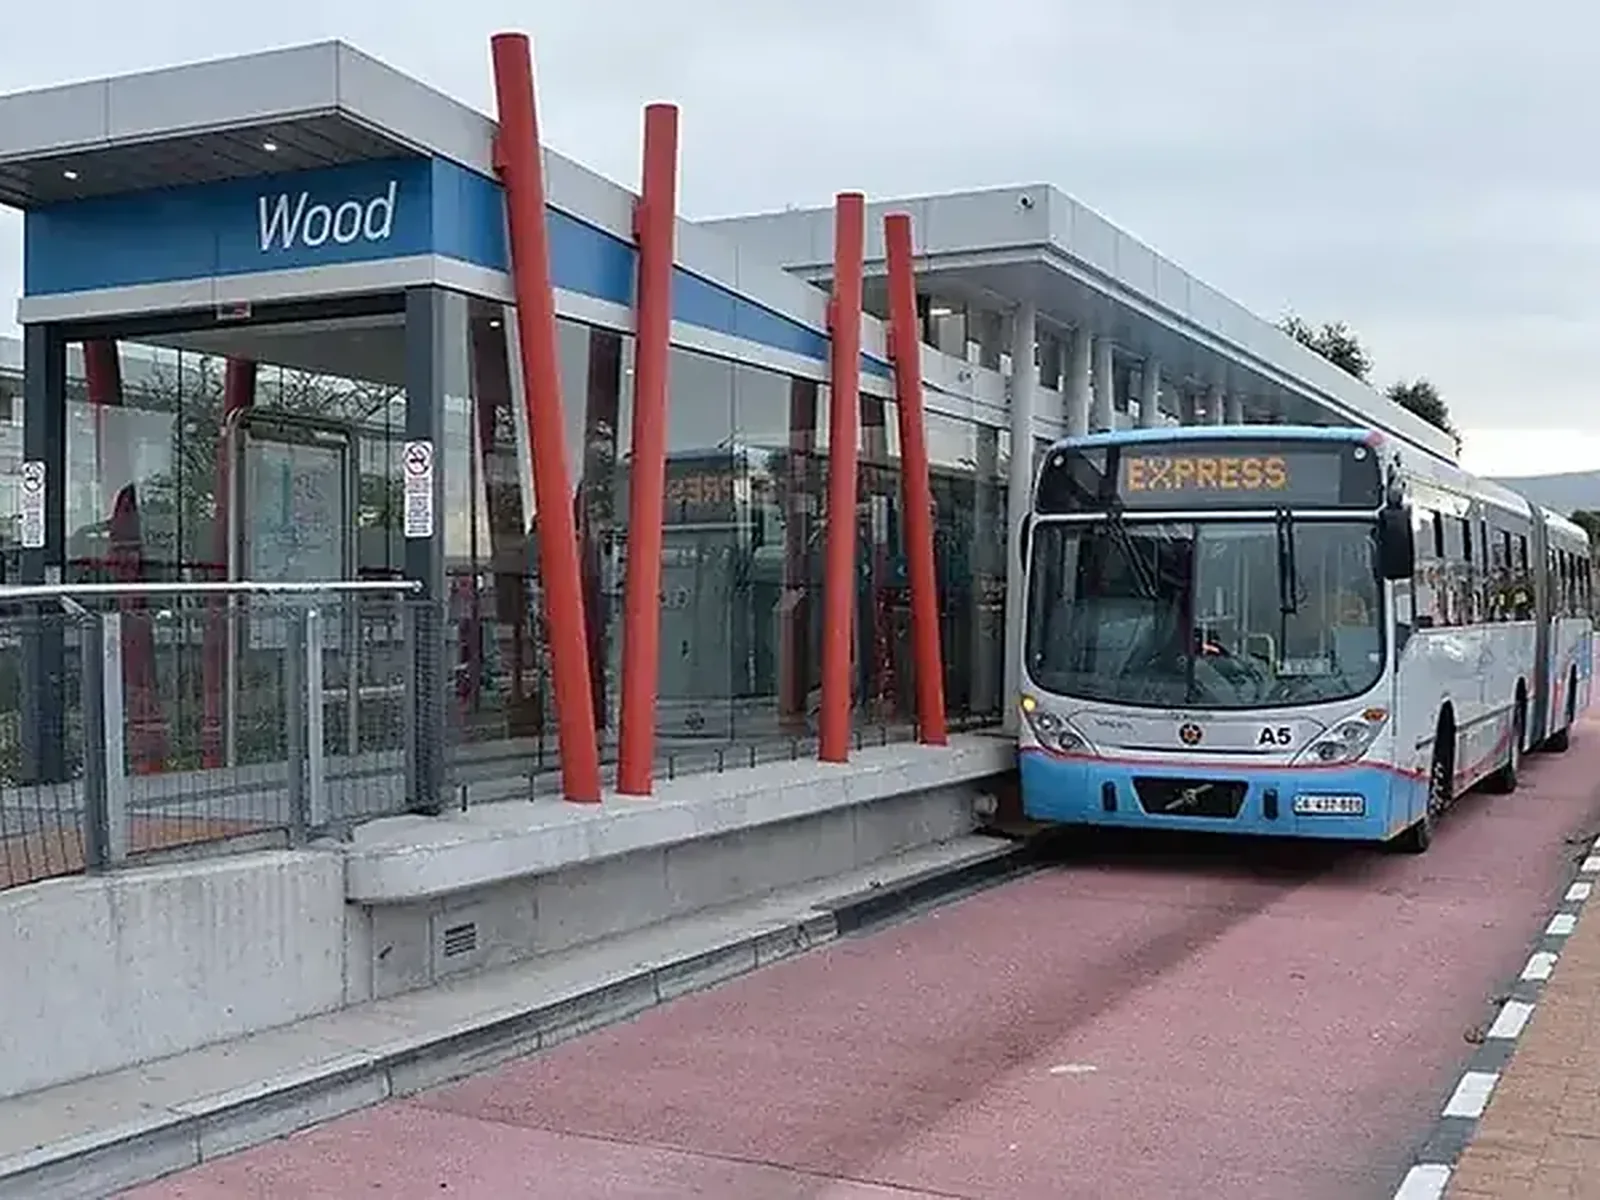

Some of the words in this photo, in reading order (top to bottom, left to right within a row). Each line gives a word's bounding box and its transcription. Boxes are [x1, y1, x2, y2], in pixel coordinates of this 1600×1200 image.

[259, 180, 397, 250] Wood
[1127, 456, 1288, 492] EXPRESS
[1259, 727, 1292, 746] A5
